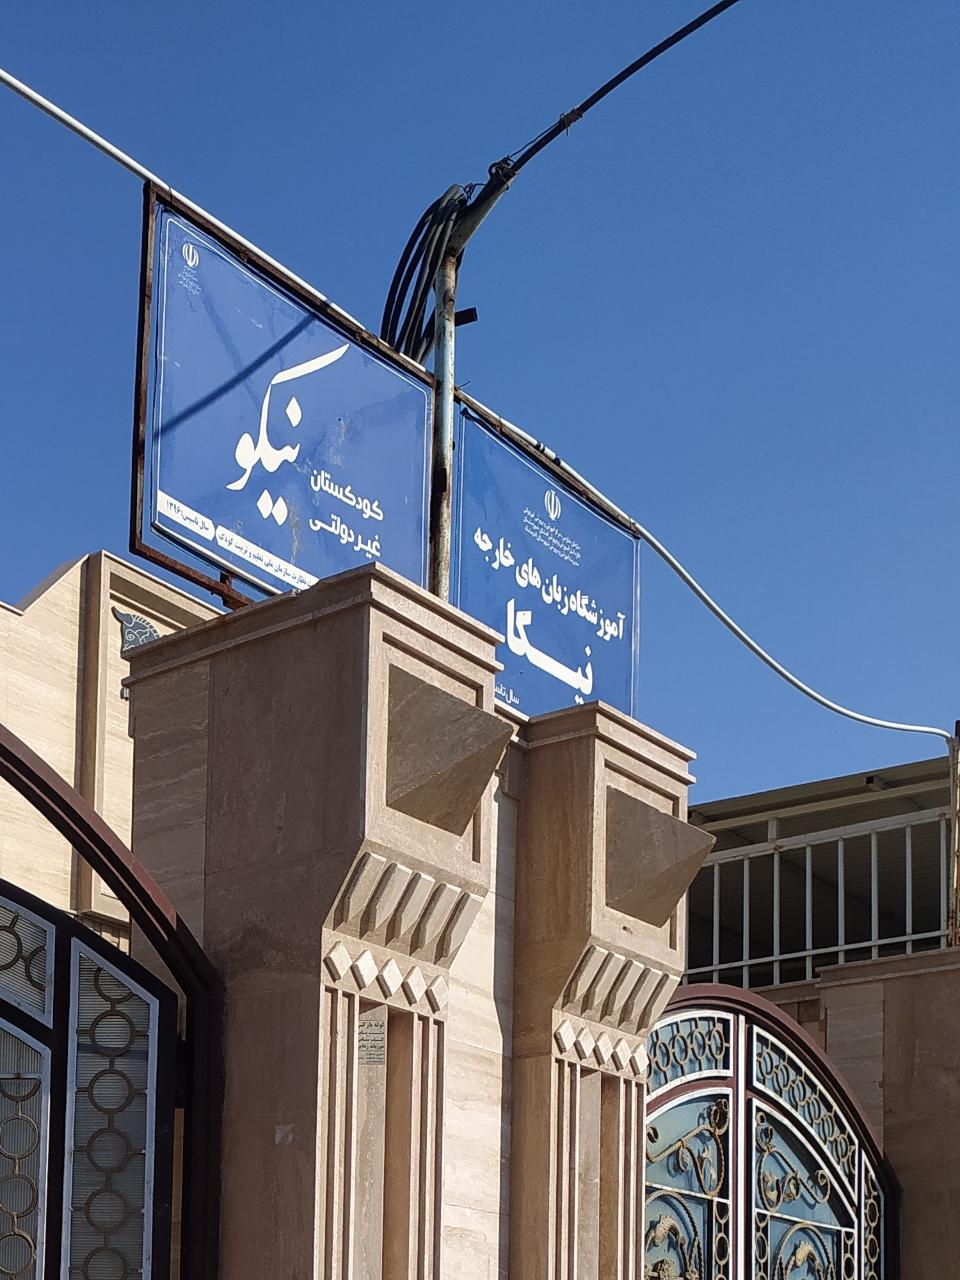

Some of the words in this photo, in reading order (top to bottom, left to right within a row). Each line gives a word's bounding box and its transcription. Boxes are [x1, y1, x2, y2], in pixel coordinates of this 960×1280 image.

[226, 343, 350, 526] نیکو
[310, 469, 384, 521] کودکستان
[309, 513, 355, 544] دولتی
[353, 534, 381, 559] غیر
[473, 526, 516, 570] خارجه
[515, 557, 542, 588] های
[541, 574, 570, 616] زبان
[569, 589, 626, 642] آموزشگاه
[505, 688, 520, 705] سال
